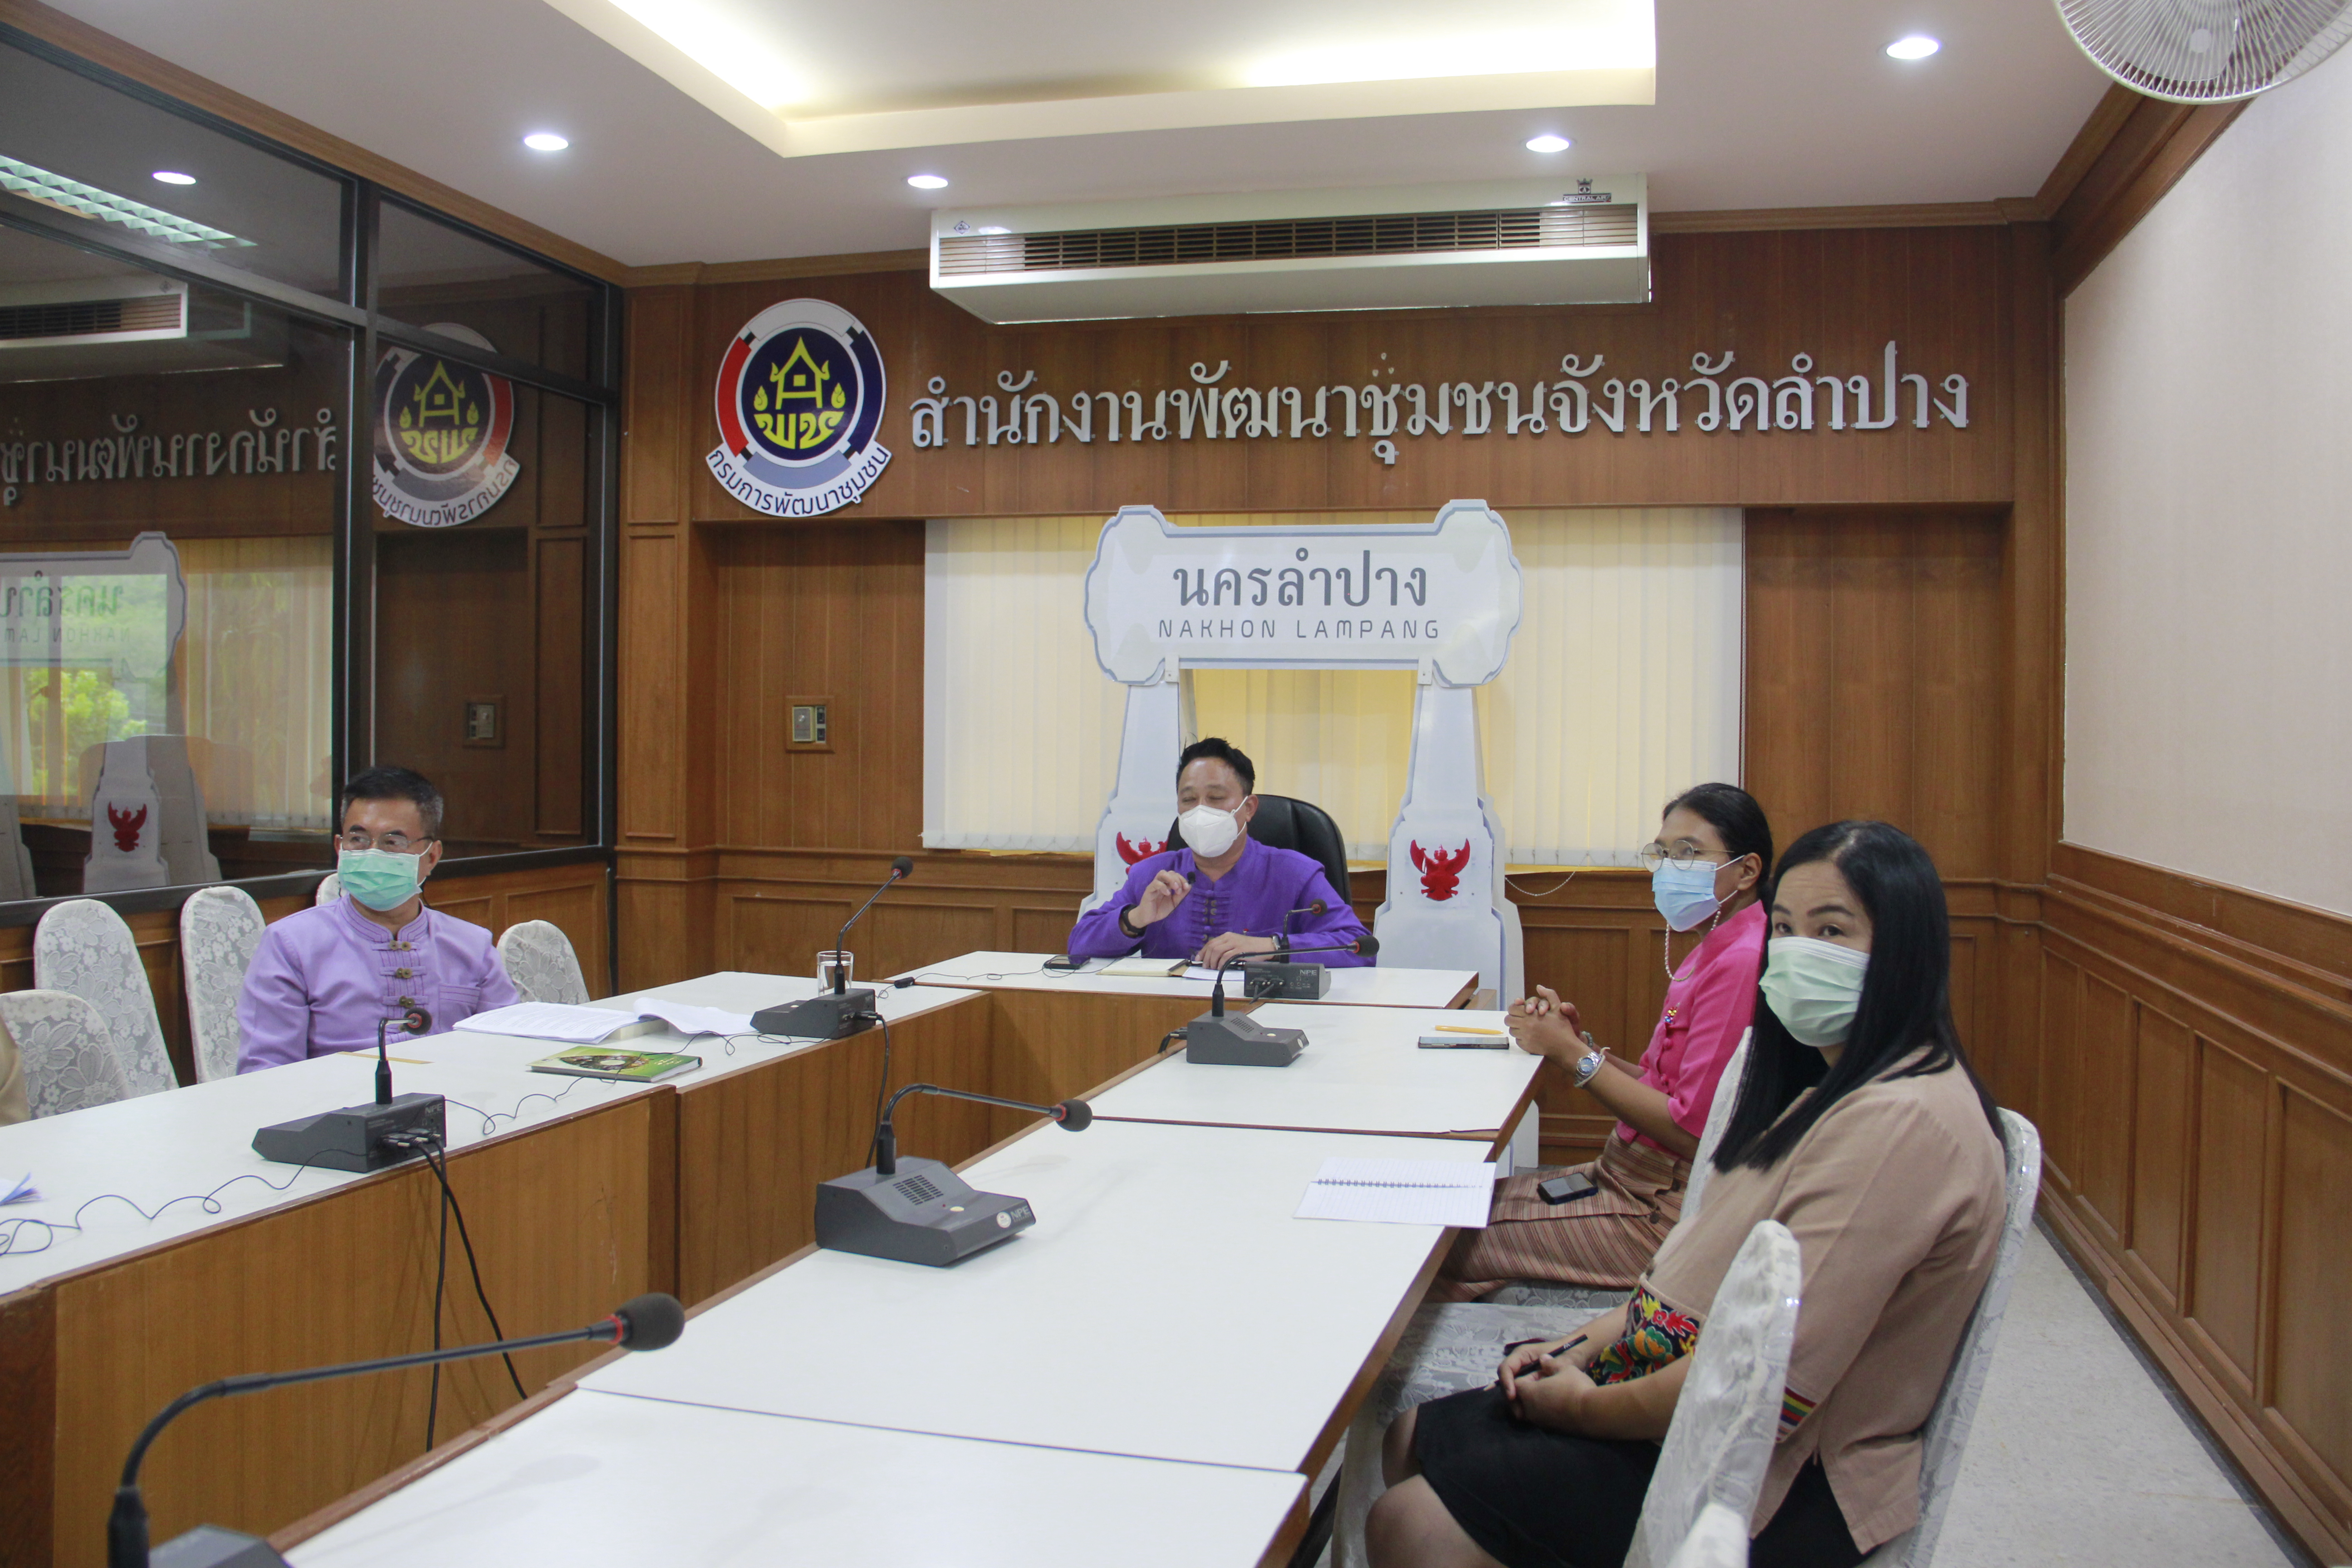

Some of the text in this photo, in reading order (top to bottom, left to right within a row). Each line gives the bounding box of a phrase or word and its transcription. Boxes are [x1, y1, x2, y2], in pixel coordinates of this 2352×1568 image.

[909, 340, 1967, 465] สำนักงานพัฒนาชุมชนจังหวัดลำปาง
[708, 446, 889, 515] กรมการพัฒนาชุมชน
[1173, 547, 1426, 607] นครลำปาง
[1159, 619, 1438, 639] NAKHON LAMPANG
[425, 1103, 443, 1114] NPE
[1010, 1205, 1030, 1219] NPE
